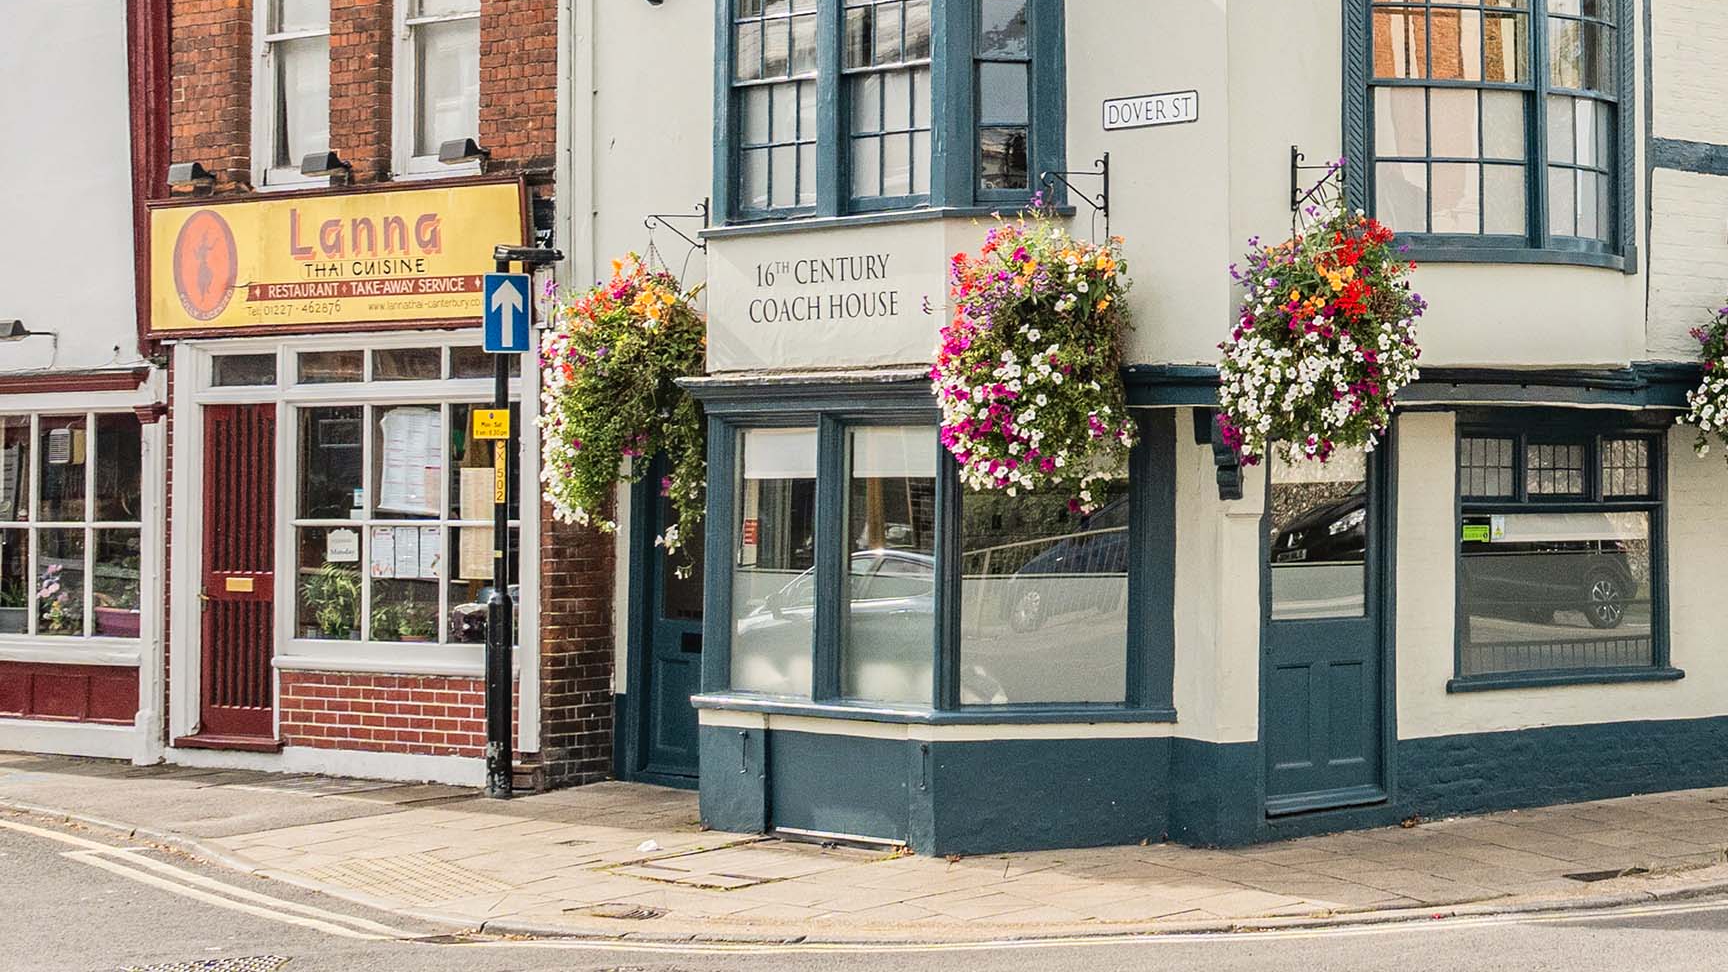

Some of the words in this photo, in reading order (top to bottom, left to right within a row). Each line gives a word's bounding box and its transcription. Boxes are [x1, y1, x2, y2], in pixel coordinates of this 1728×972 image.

[1109, 99, 1166, 124] DOVER
[1172, 97, 1191, 118] ST
[290, 208, 442, 260] Lanna
[304, 263, 344, 278] THAI
[352, 259, 425, 275] CUISINE
[794, 254, 890, 284] CENTURY
[268, 283, 338, 298] RESTAURANT
[350, 279, 417, 295] TAKE-AWAY
[419, 277, 465, 293] SERVICE
[368, 298, 481, 310] www.lannathai-canterbury.co
[749, 296, 820, 323] COACH
[830, 291, 898, 319] HOUSE
